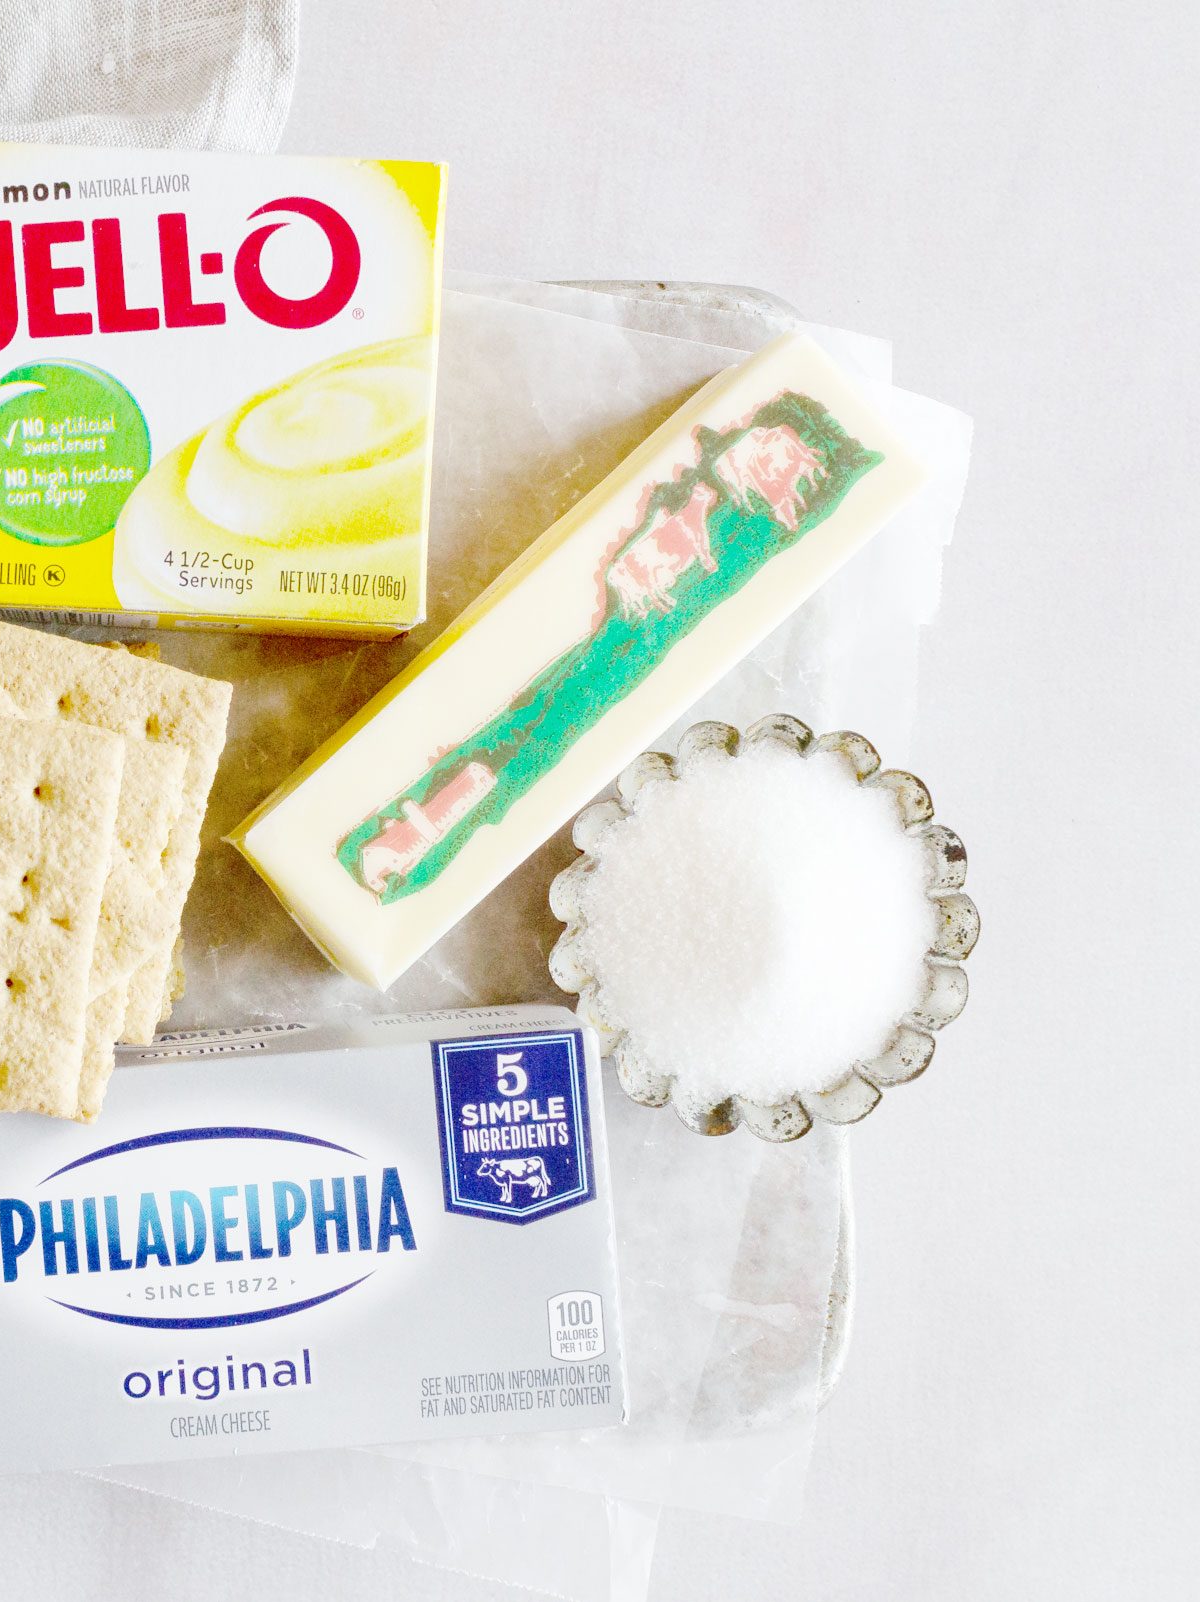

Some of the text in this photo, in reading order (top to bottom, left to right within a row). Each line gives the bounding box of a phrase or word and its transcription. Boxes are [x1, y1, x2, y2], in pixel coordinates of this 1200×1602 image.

[79, 177, 138, 199] NATURAL
[141, 174, 190, 195] FLAVOR
[21, 413, 115, 439] NO artificial
[23, 435, 107, 456] sweeteners
[4, 464, 135, 491] NO high fructose
[6, 488, 87, 510] corn syrup
[164, 551, 174, 567] 4
[179, 571, 253, 595] Servings
[280, 570, 406, 601] NET WT 3.4 OZ (96g)
[114, 1023, 307, 1045] ADELPHIA
[469, 1022, 517, 1032] CREAM
[497, 1052, 528, 1097] 5
[461, 1096, 566, 1126] SIMPLE
[463, 1121, 569, 1154] INGREDIENTS
[144, 1276, 279, 1301] SINCE 1872
[556, 1299, 593, 1327] 100
[556, 1328, 598, 1342] CALORIES
[560, 1340, 597, 1353] PER 1 OZ
[123, 1348, 312, 1401] original
[421, 1364, 611, 1397] SEE NUTRITION INFORMATION FOR
[420, 1385, 612, 1418] FAT AND SATURATED FAT CONTENT
[170, 1410, 271, 1438] CREAM CHEESE
